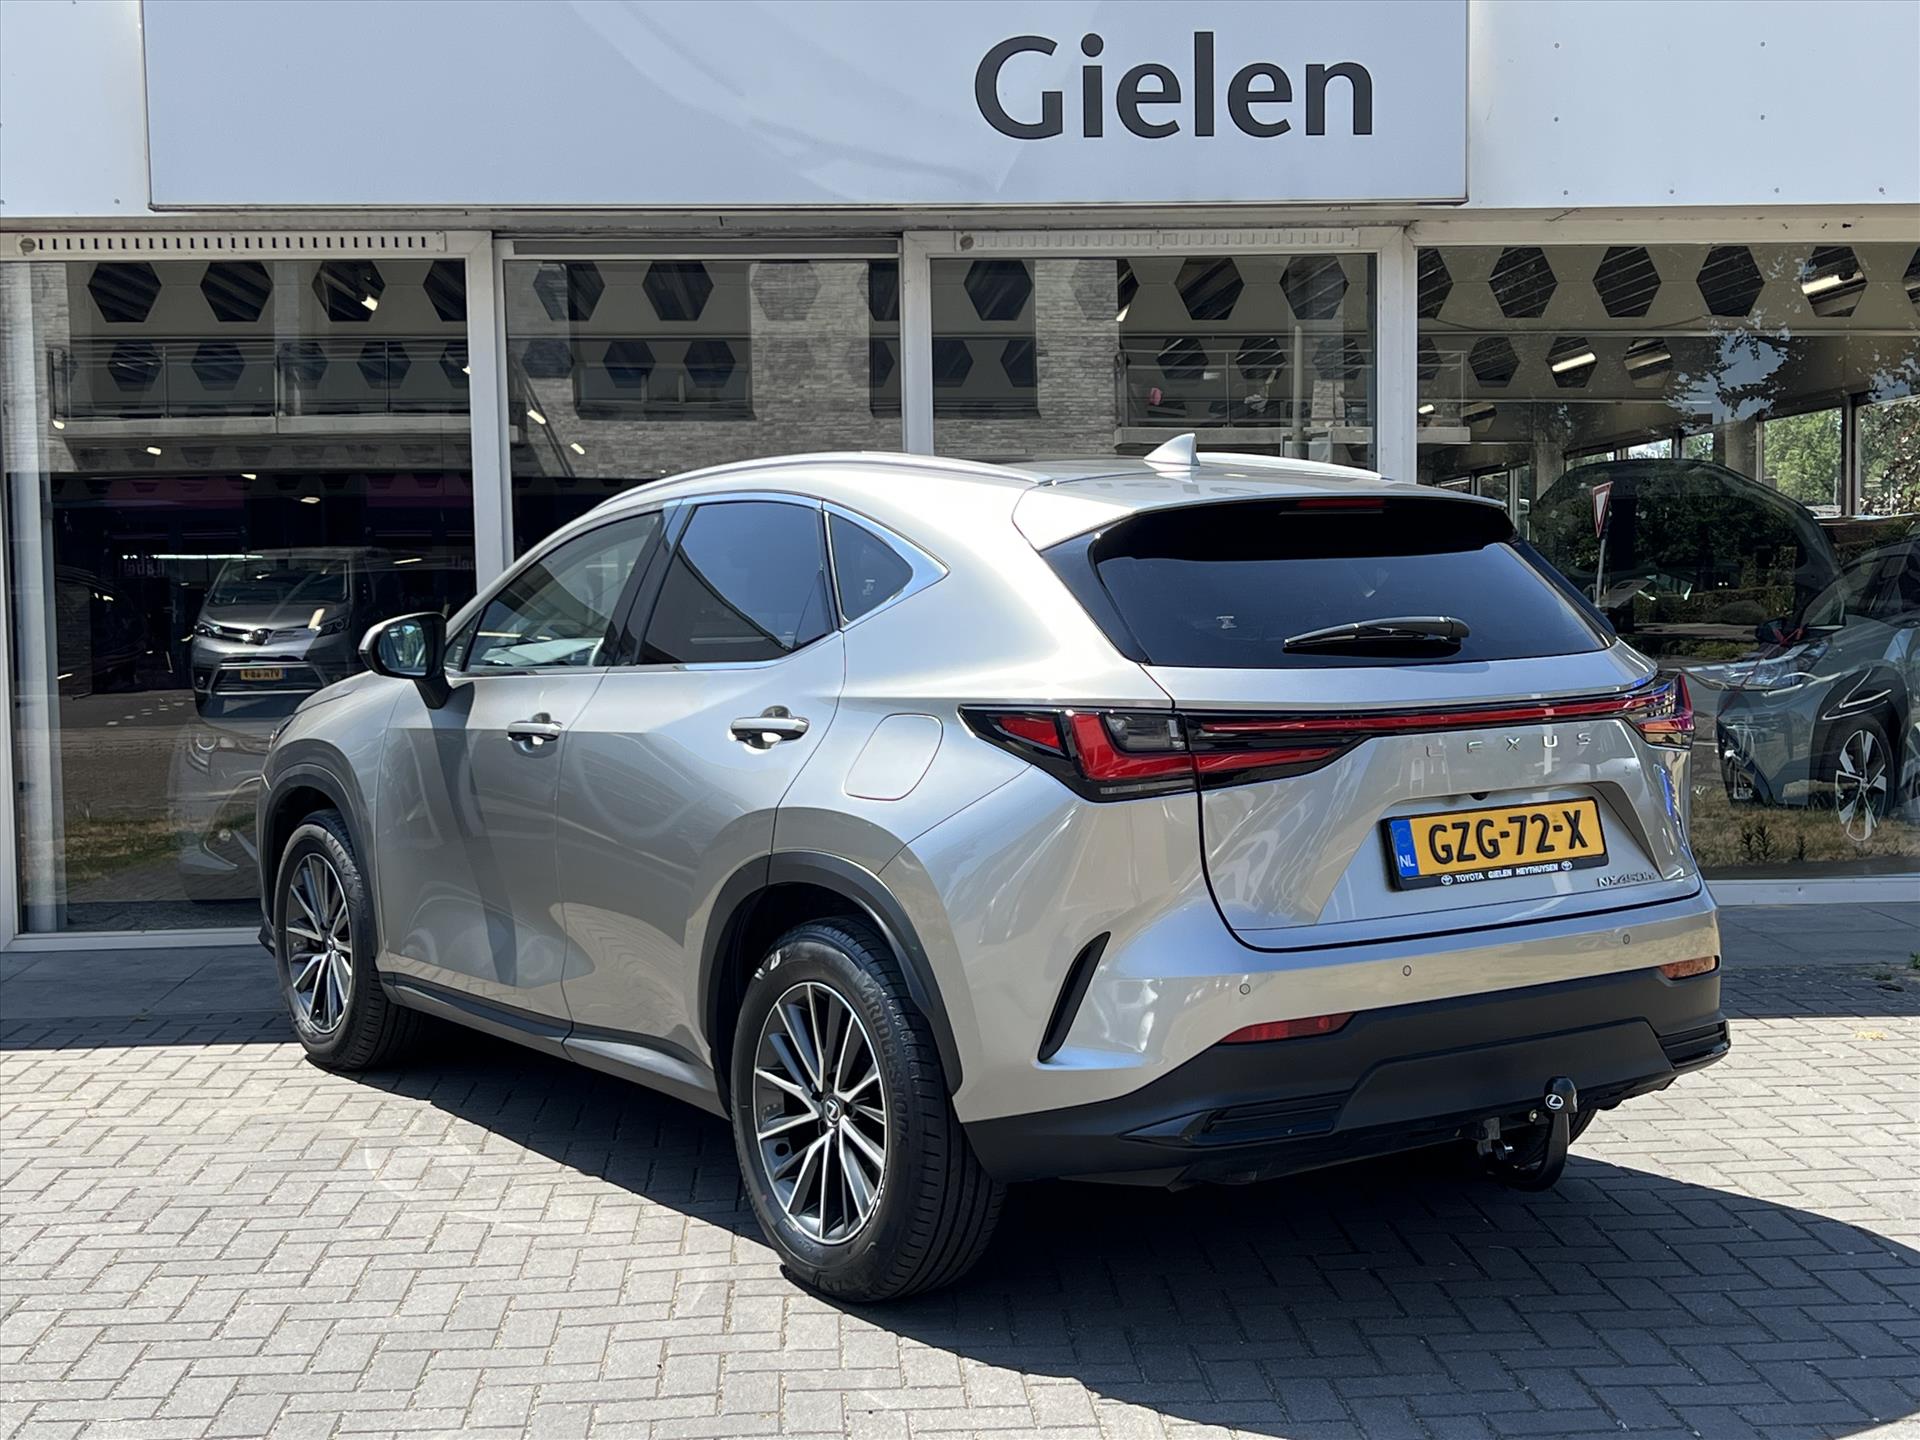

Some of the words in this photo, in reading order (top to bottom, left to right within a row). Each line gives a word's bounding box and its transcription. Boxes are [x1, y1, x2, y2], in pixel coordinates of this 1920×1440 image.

[974, 31, 1373, 140] Gielen
[1425, 731, 1592, 758] LEXUS
[1428, 809, 1588, 864] GZG-72-X
[1400, 855, 1416, 868] NL
[1455, 871, 1485, 883] TOYOTA
[1488, 868, 1512, 879] GIELEN
